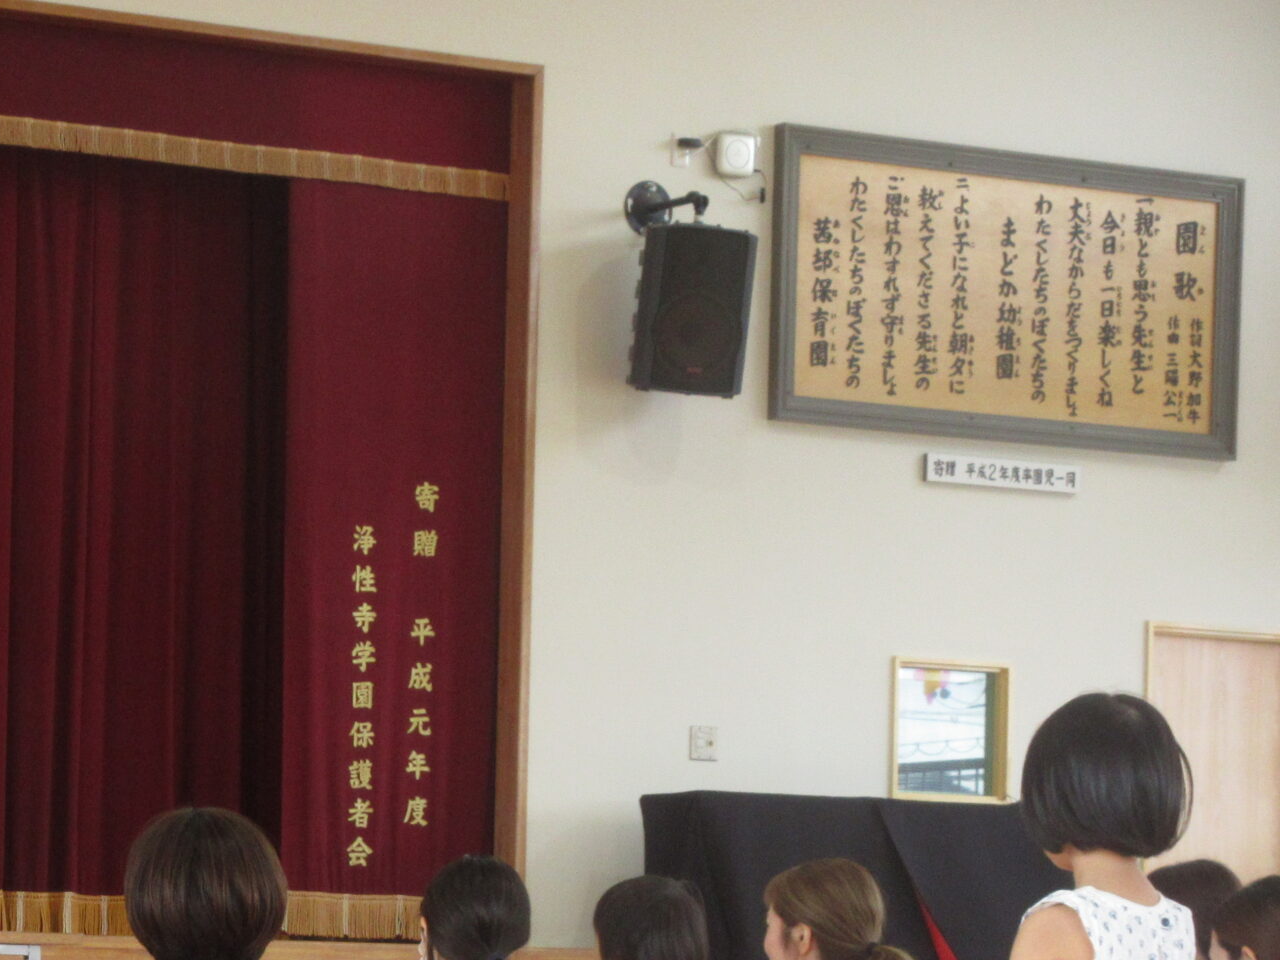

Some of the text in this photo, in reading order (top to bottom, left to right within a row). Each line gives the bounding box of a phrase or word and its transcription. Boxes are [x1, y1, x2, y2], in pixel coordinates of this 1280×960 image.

[996, 217, 1017, 380] まどか幼稚園
[1097, 210, 1119, 407] 今日も一日楽しくね
[1173, 221, 1198, 302] 園歌
[346, 524, 377, 867] 浄性寺学園保護者会
[404, 481, 440, 827] 寄贈 平成元年度
